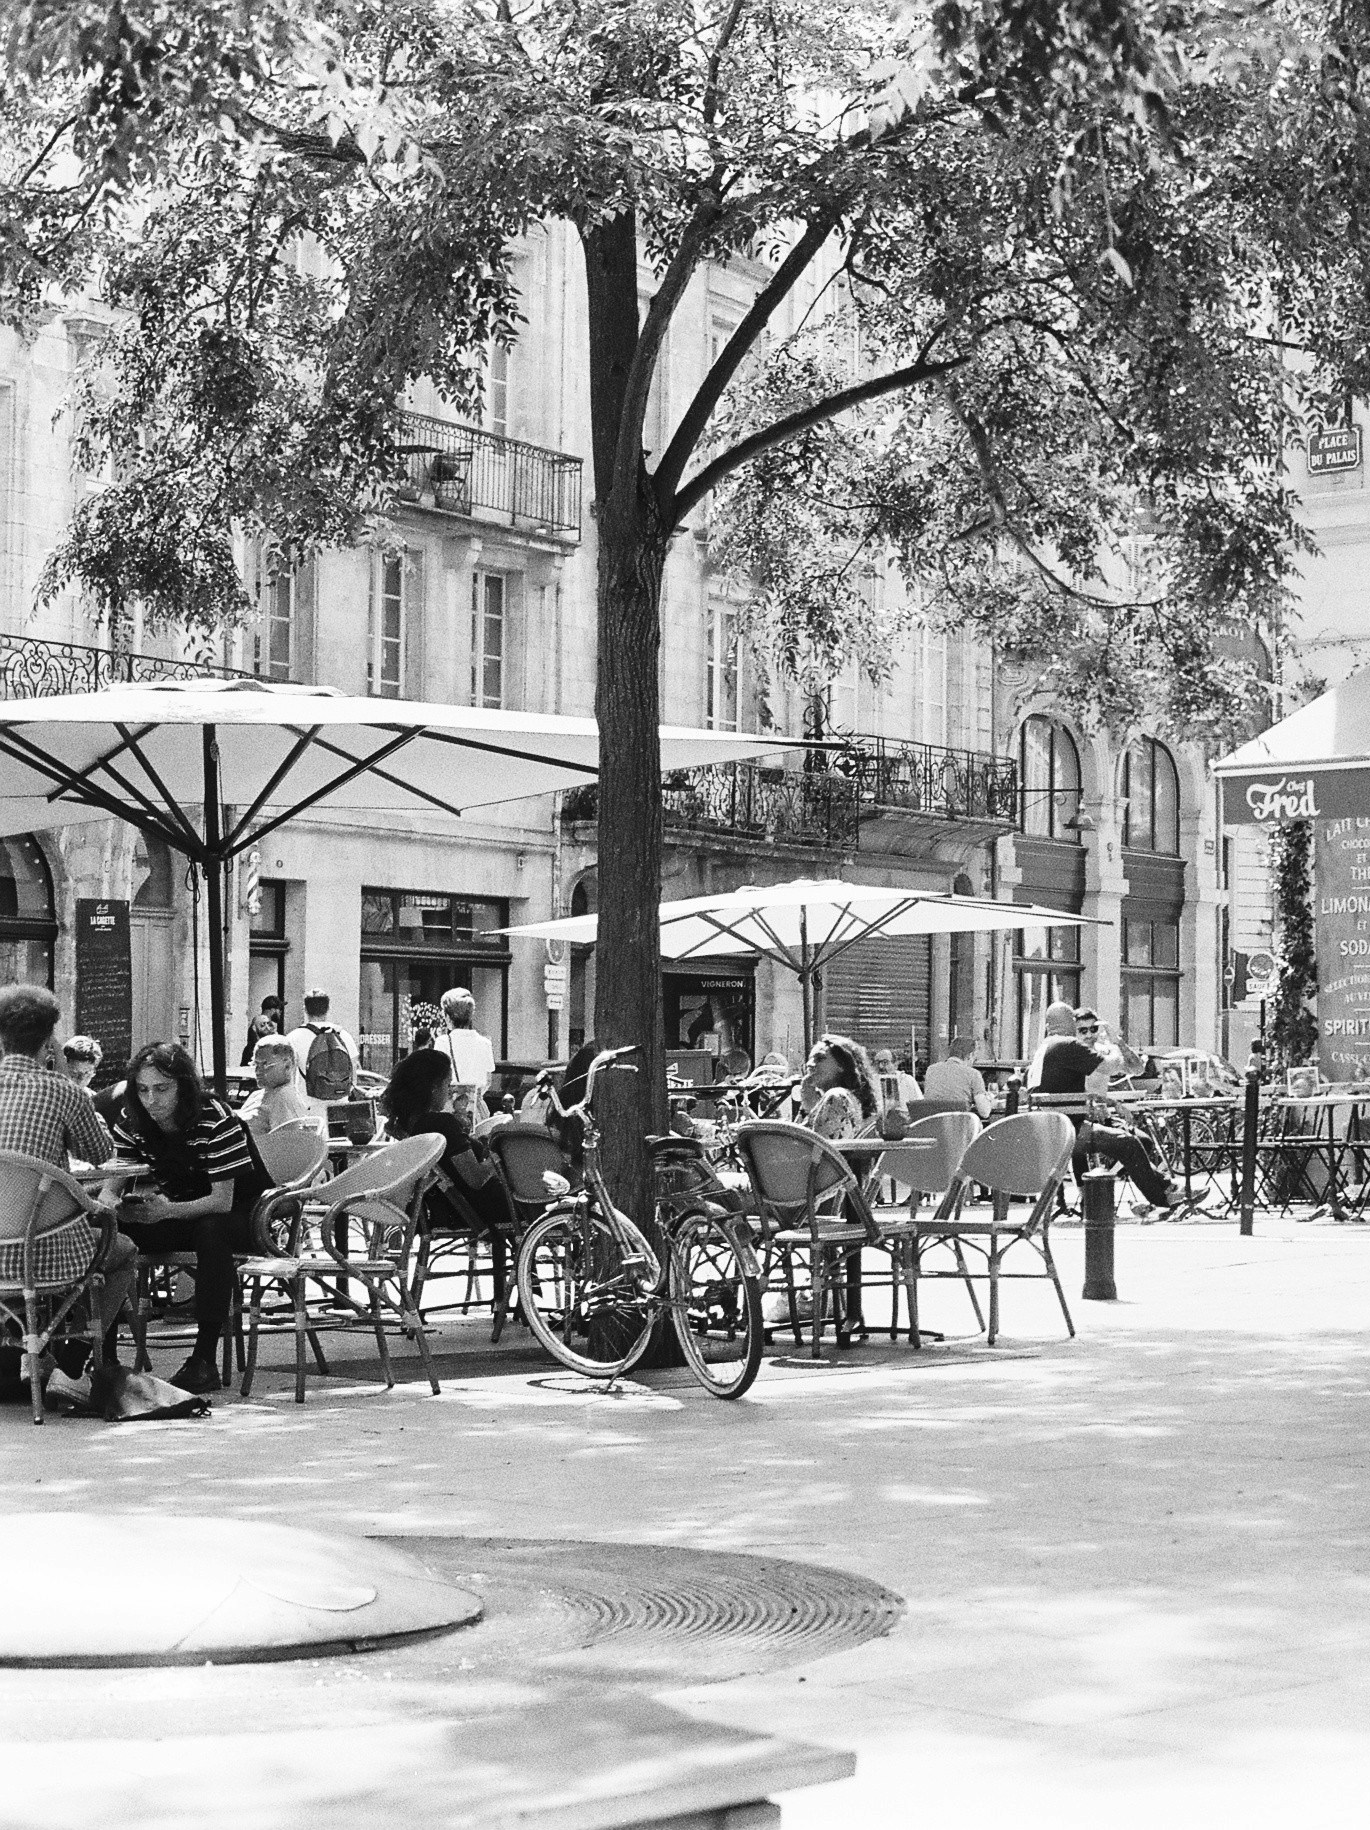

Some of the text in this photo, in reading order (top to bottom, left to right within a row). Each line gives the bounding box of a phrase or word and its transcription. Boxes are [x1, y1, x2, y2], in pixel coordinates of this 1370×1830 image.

[1319, 435, 1348, 449] PLACE
[1311, 450, 1356, 466] DU PALAIS
[1246, 777, 1321, 820] Fred
[1326, 818, 1352, 842] LAIT
[1357, 853, 1367, 864] ET
[1357, 920, 1368, 931] ET
